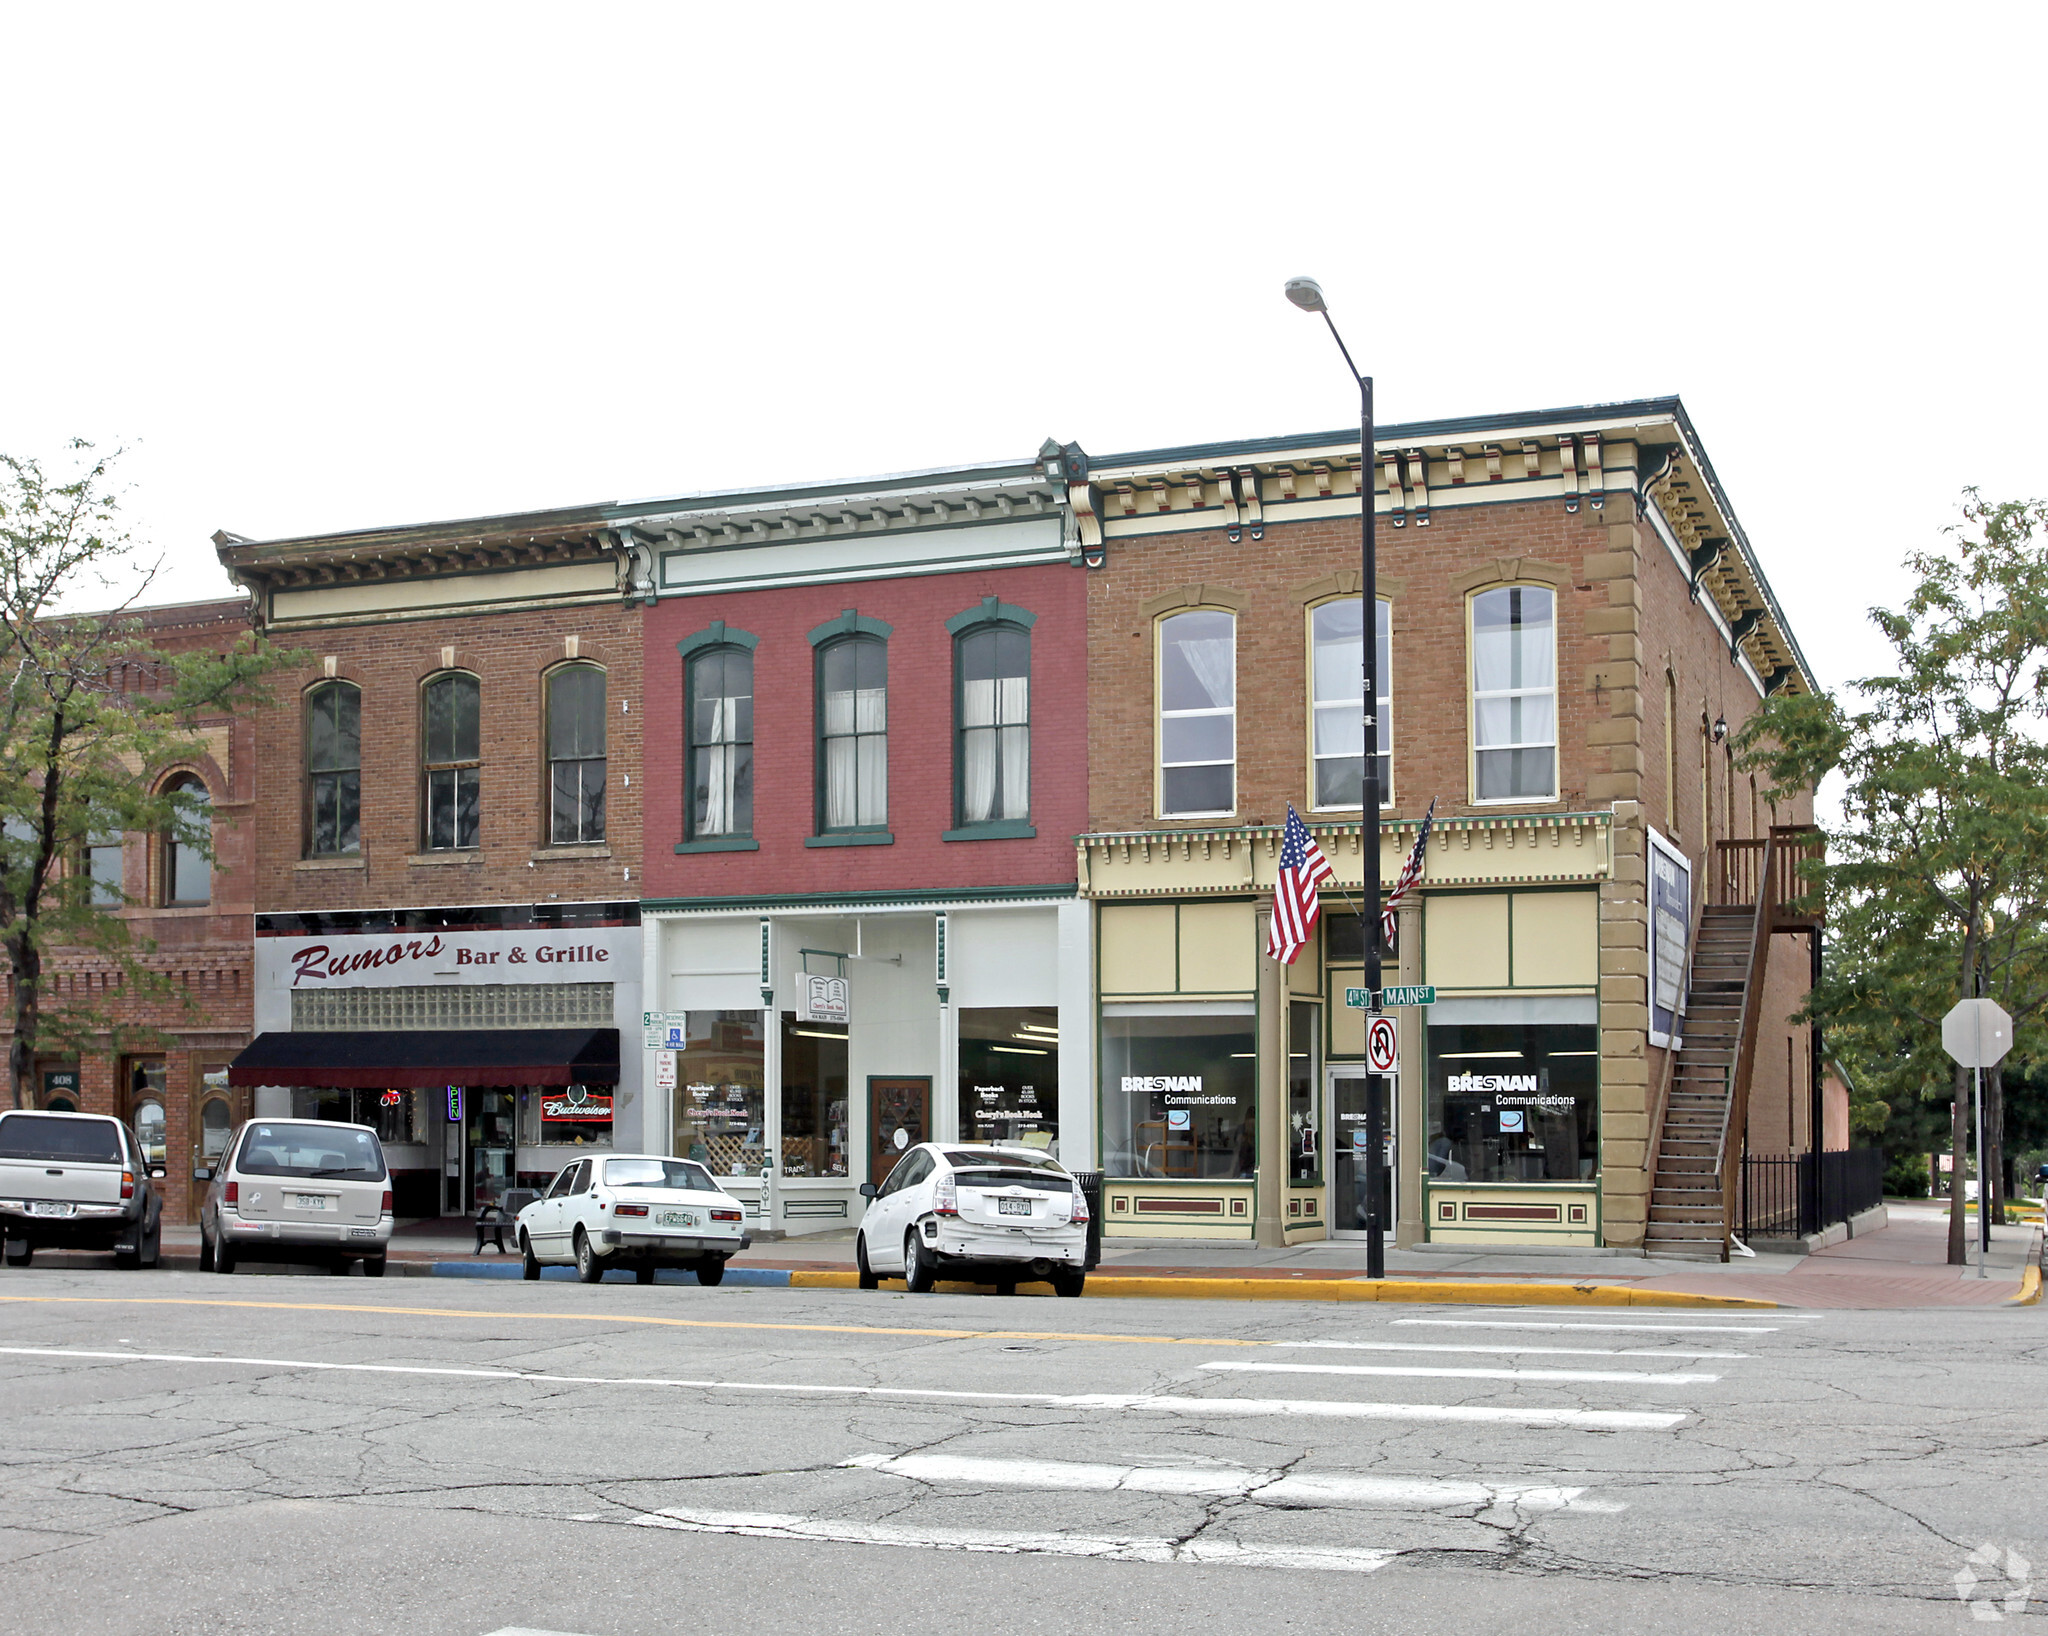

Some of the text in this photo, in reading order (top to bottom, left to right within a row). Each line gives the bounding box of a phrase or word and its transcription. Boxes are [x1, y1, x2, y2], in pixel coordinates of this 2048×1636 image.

[291, 935, 609, 986] Rumors Bar & Grille
[1360, 990, 1369, 1006] ST
[1386, 987, 1430, 1005] MAIN ST
[644, 1014, 650, 1025] 2
[52, 1075, 73, 1085] 408
[1121, 1076, 1202, 1092] BRESNAN
[1447, 1075, 1537, 1092] BRESNAN
[973, 1085, 1005, 1093] Paperback
[1164, 1094, 1237, 1105] Communications
[1495, 1094, 1575, 1105] Communications
[543, 1101, 612, 1117] Budweiser
[975, 1109, 1043, 1119] Cheryl's Book Nook
[784, 1165, 805, 1174] TRADE
[831, 1164, 847, 1173] SELL
